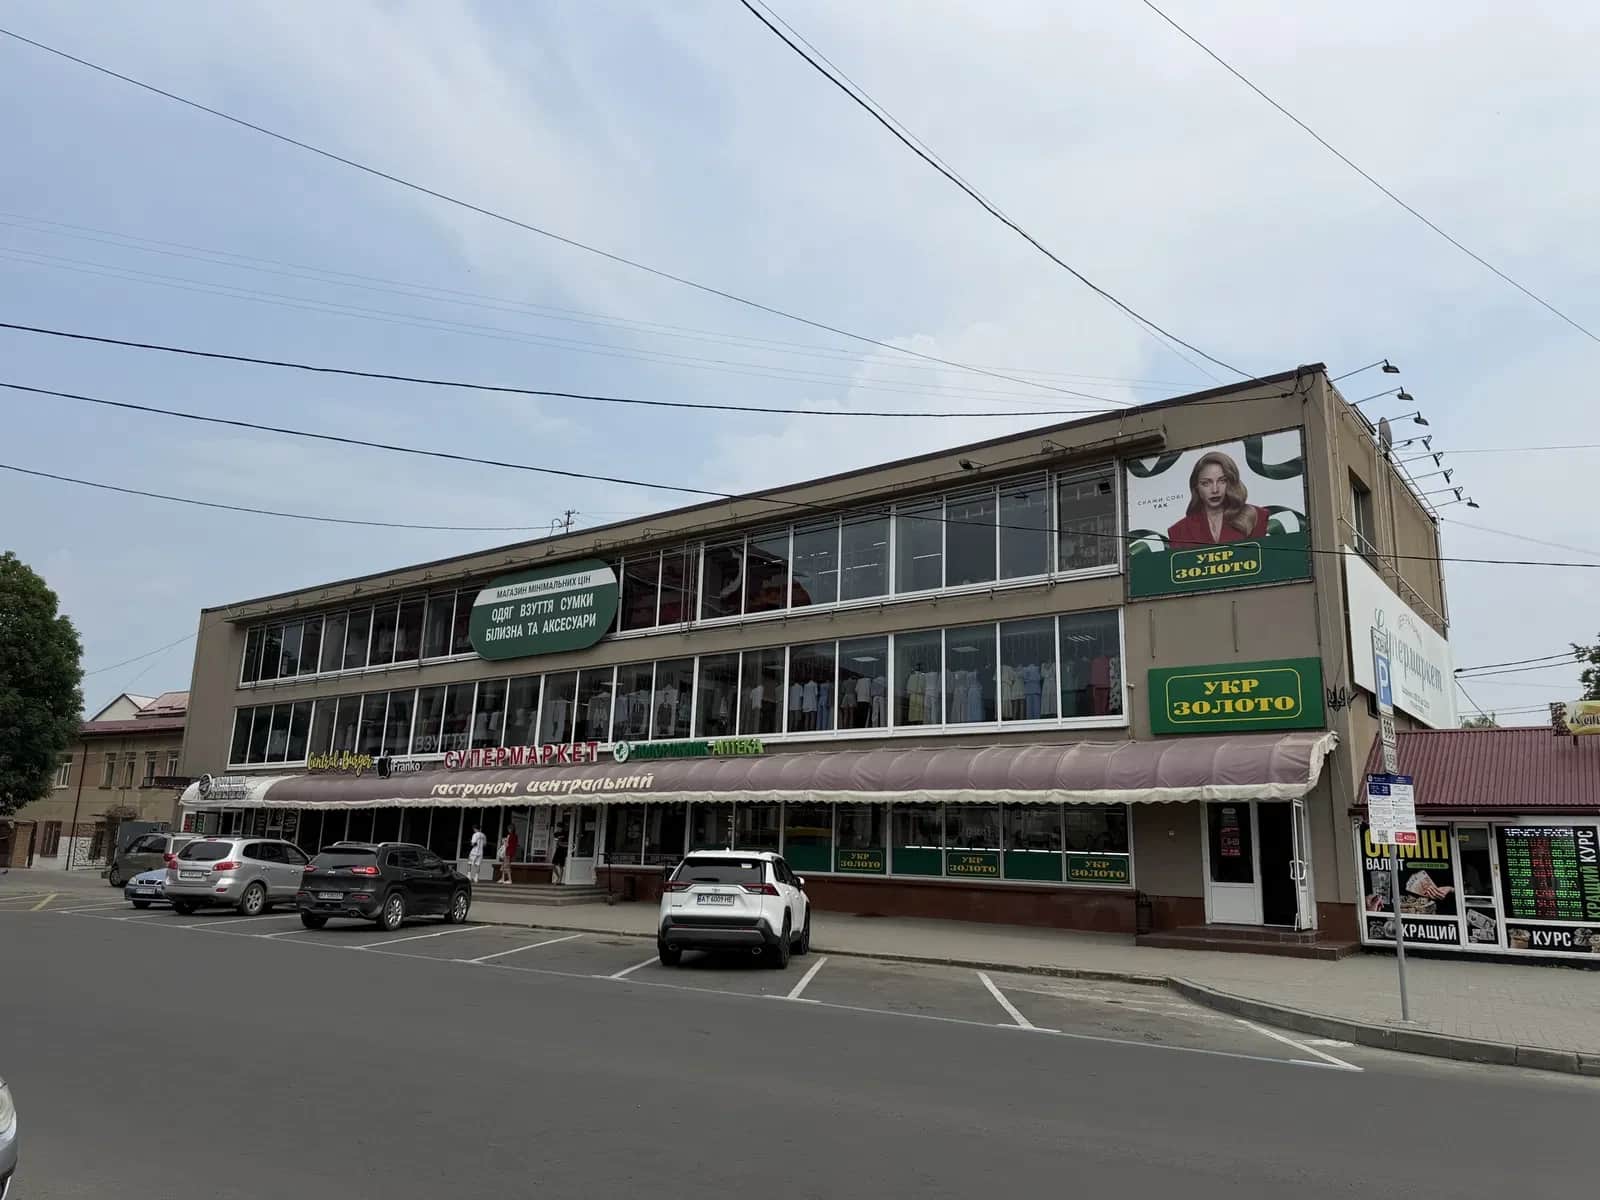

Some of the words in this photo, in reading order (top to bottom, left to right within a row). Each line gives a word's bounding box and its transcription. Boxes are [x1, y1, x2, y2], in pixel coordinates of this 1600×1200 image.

[1196, 550, 1234, 564] УКР
[1175, 560, 1257, 579] ЗОЛОТО
[496, 586, 529, 599] МАГАЗИН
[528, 579, 577, 594] МІНІМАЛЬНИХ
[577, 575, 591, 587] ЦІН
[491, 606, 515, 624] ОДЯГ
[520, 600, 554, 617] ВЗУТТЯ
[560, 593, 594, 611] СУМКИ
[485, 624, 523, 642] БІЛИЗНА
[527, 621, 538, 636] ТА
[542, 613, 597, 633] АКСЕСУАРИ
[1203, 679, 1259, 696] УКР
[1173, 696, 1295, 716] ЗОЛОТО
[414, 733, 468, 752] ВЗУТТЯ
[712, 738, 764, 755] АПТЕКА
[342, 750, 374, 777] Burger
[444, 741, 600, 769] СУПЕРМАРКЕТ
[391, 760, 421, 773] iFranko
[431, 781, 519, 798] гастроном
[526, 773, 654, 795] центральний
[1578, 830, 1598, 863] КУРС
[840, 860, 881, 869] ЗОЛОТО
[850, 852, 870, 860] УКР
[962, 856, 984, 864] УКР
[1085, 860, 1110, 869] УКР
[950, 864, 996, 873] ЗОЛОТО
[1071, 868, 1125, 879] ЗОЛОТО
[1580, 865, 1600, 918] КРАЩИЙ
[1401, 923, 1457, 941] КРАЩИЙ
[1532, 930, 1571, 947] КУРС
